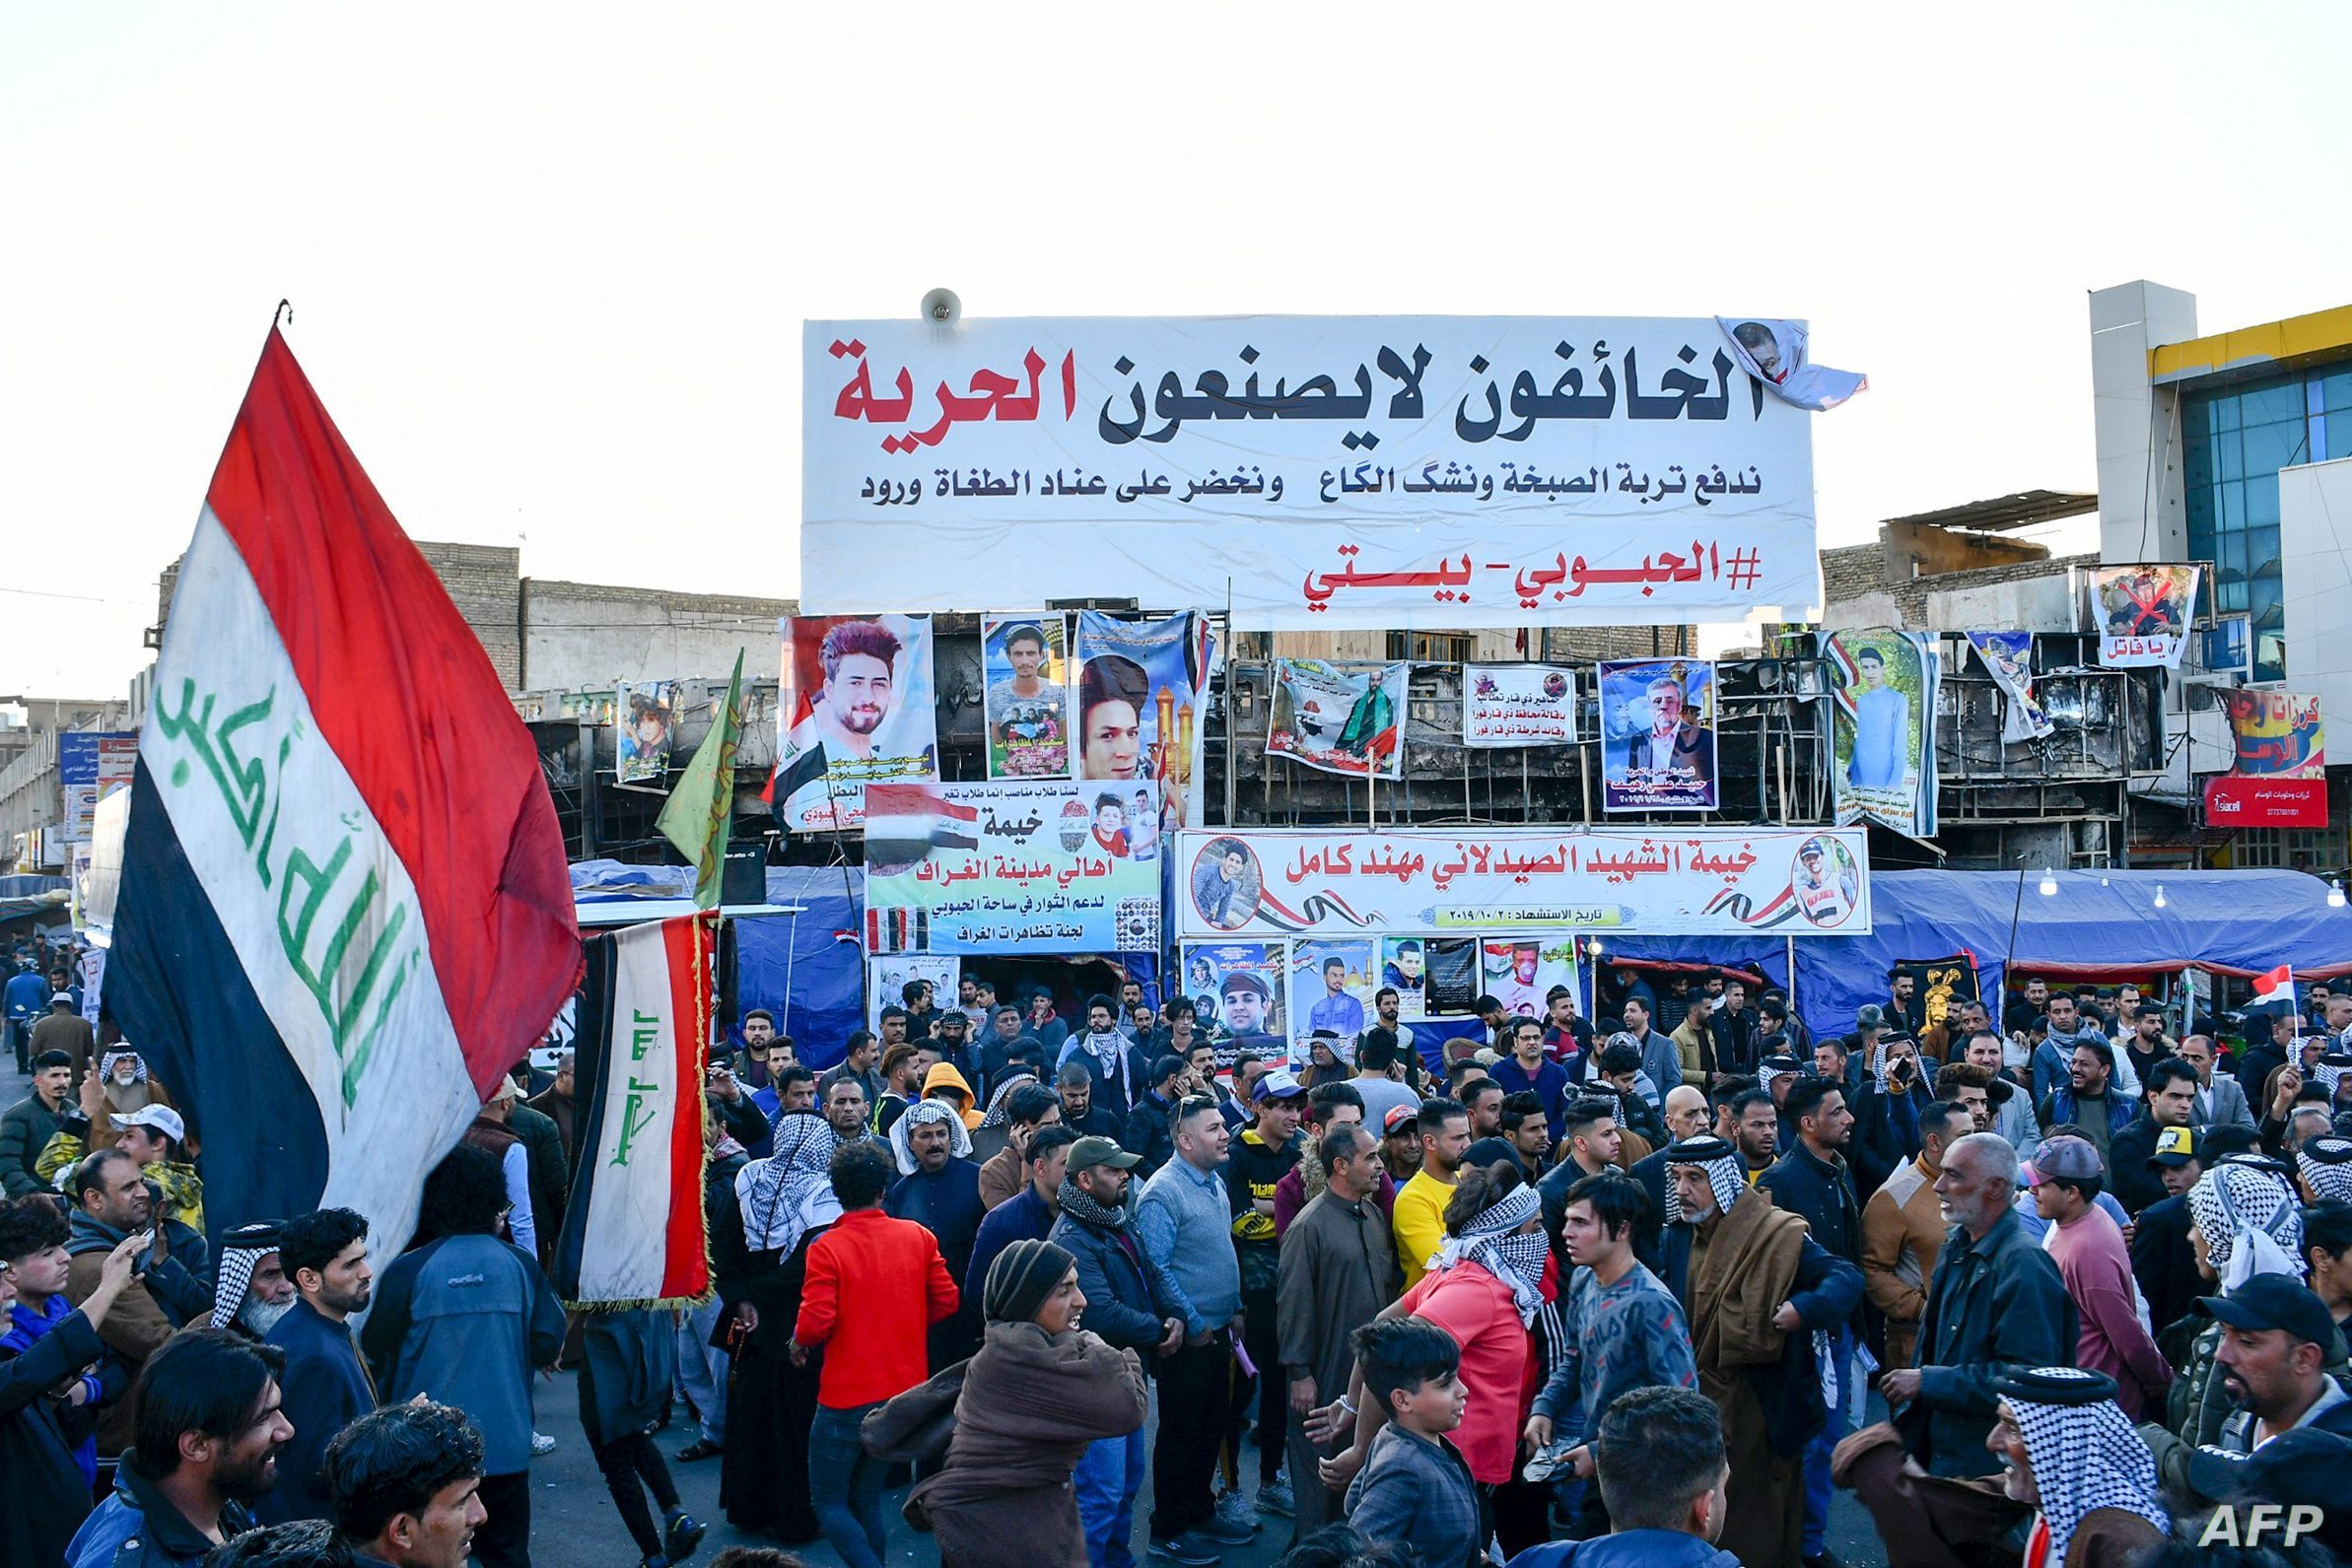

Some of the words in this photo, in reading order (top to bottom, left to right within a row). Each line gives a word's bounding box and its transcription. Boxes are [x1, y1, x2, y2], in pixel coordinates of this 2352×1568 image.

[828, 338, 1075, 454] الحرية
[861, 474, 922, 506] ورود
[934, 467, 1030, 497] الطغاة
[1040, 467, 1107, 496] عناد
[1176, 465, 1283, 503] ونخضر
[1500, 462, 1609, 503] الصبخة
[1616, 462, 1687, 504] تربة
[1694, 463, 1762, 506] ندفع
[1303, 544, 1473, 612] بيتي
[2108, 638, 2144, 659] قاتل
[2272, 695, 2319, 730] كرزات
[942, 788, 959, 801] تغير
[963, 788, 984, 798] طلاب
[1005, 787, 1033, 799] مناصب
[1035, 786, 1057, 797] طلاب
[1060, 786, 1078, 796] لسنا
[982, 806, 1043, 845] خيمة
[916, 857, 987, 887] الغراف
[995, 854, 1051, 888] مدينة
[1057, 850, 1113, 889] أهالي
[1285, 844, 1352, 884] كامل
[1360, 844, 1424, 884] مهند
[1432, 842, 1578, 890] الصيدلاني
[1586, 838, 1680, 884] الشهيد
[1689, 840, 1757, 884] خيمة
[932, 898, 980, 919] الحبوبي
[983, 895, 1016, 912] ساحة
[1019, 896, 1033, 918] في
[1035, 895, 1070, 913] الثوار
[1072, 895, 1104, 911] لدعم
[1515, 908, 1571, 920] الاستشهاد
[1575, 909, 1602, 922] تاريخ
[957, 926, 996, 943] الغراف
[1000, 923, 1053, 944] تظاهرات
[1057, 923, 1082, 938] لجنة
